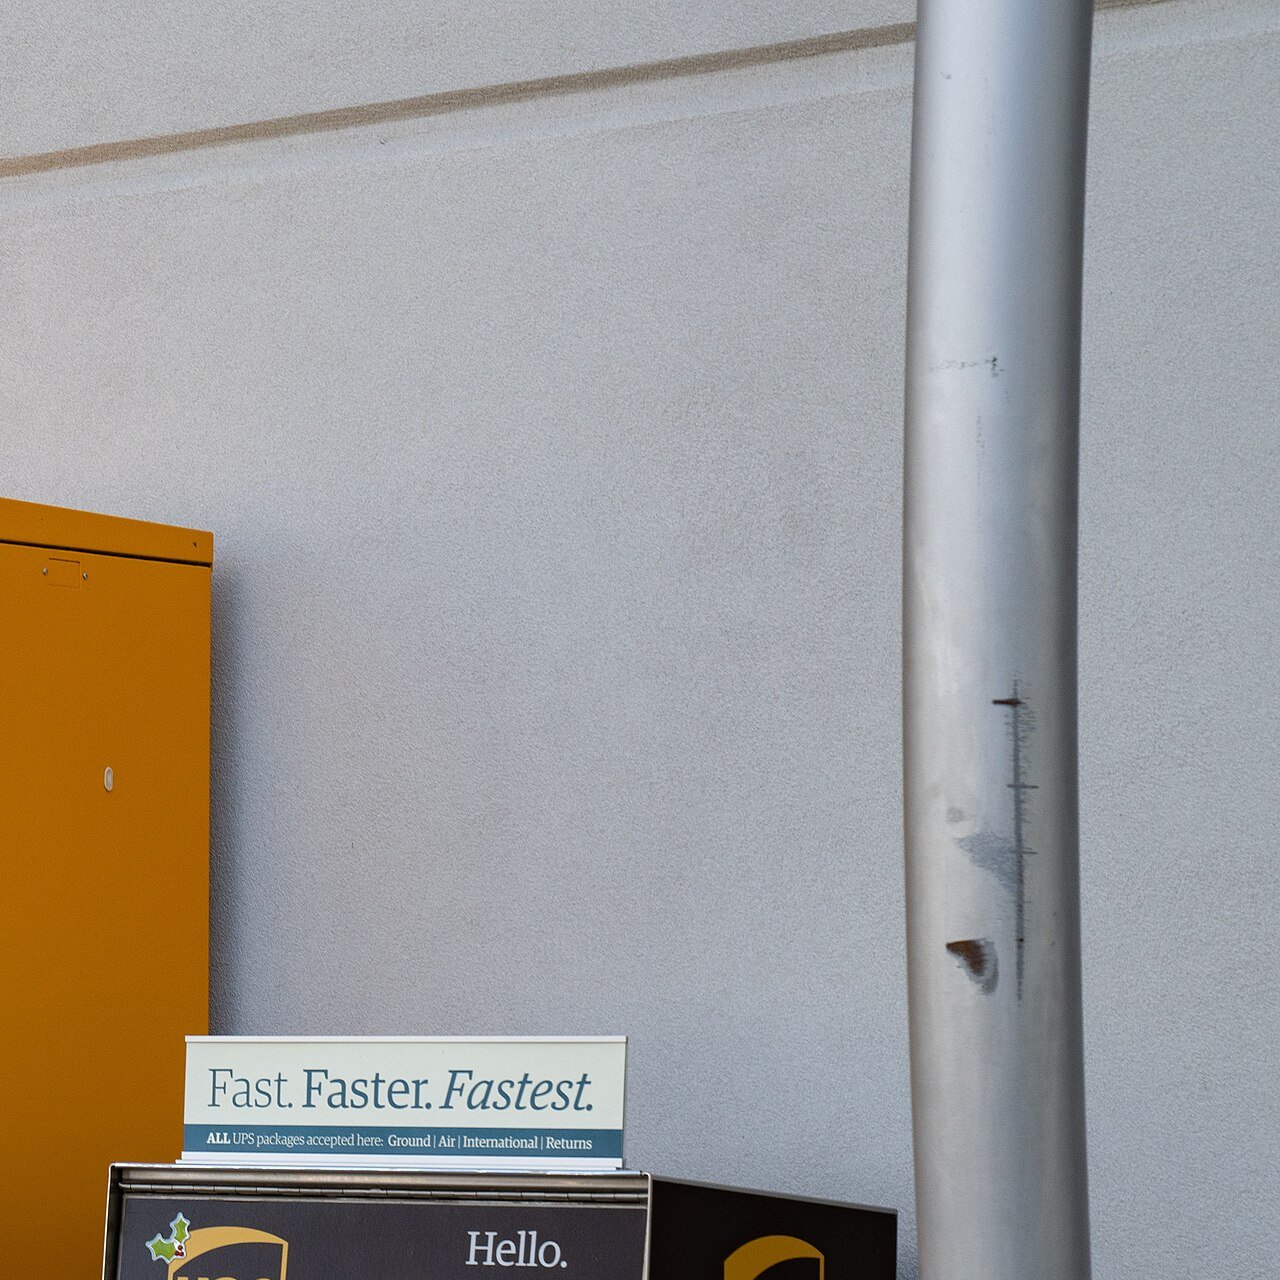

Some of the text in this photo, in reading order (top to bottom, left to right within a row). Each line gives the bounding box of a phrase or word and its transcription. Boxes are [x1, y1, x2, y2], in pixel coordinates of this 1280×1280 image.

[208, 1068, 593, 1111] Fast. Faster. Fastest.
[206, 1132, 593, 1150] ALL UPS packages accepted here: Ground Air International Returns
[465, 1231, 568, 1269] Hello.
